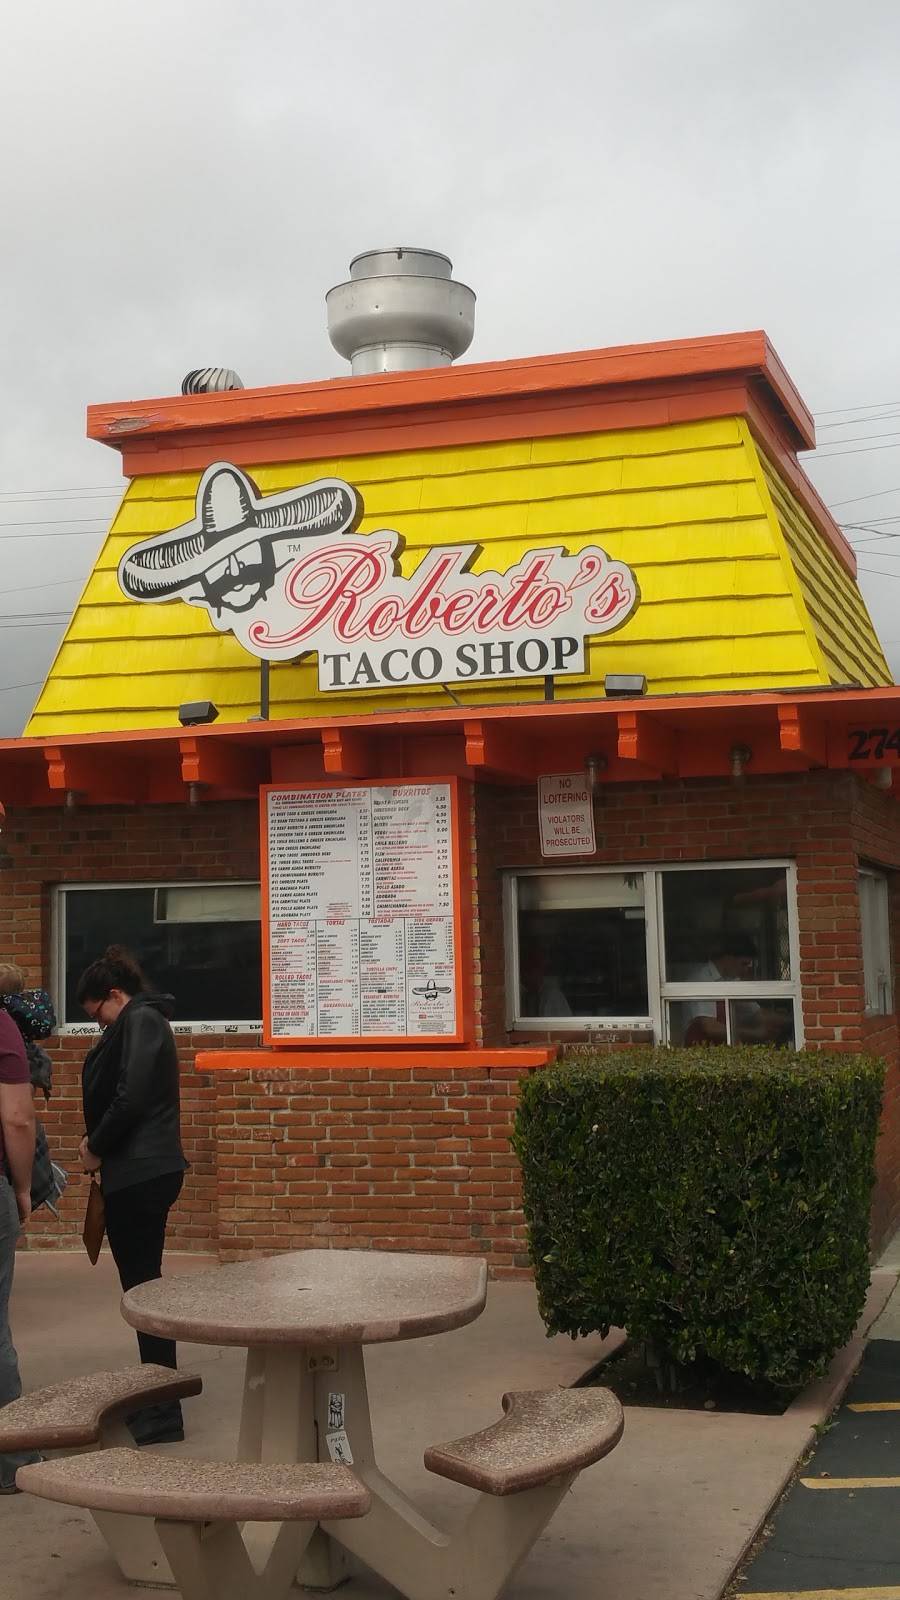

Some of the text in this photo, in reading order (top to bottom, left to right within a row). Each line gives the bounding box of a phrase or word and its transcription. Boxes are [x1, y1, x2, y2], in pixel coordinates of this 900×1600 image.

[288, 544, 301, 552] TM
[249, 541, 631, 648] Roberto's
[323, 637, 578, 686] TACO SHOP
[560, 779, 571, 788] NO
[272, 793, 333, 801] COMBINATION
[393, 788, 431, 797] BURRITOS
[543, 792, 588, 804] LOITERING
[548, 815, 585, 824] VIOLATORS
[546, 837, 590, 846] PROSECUTED
